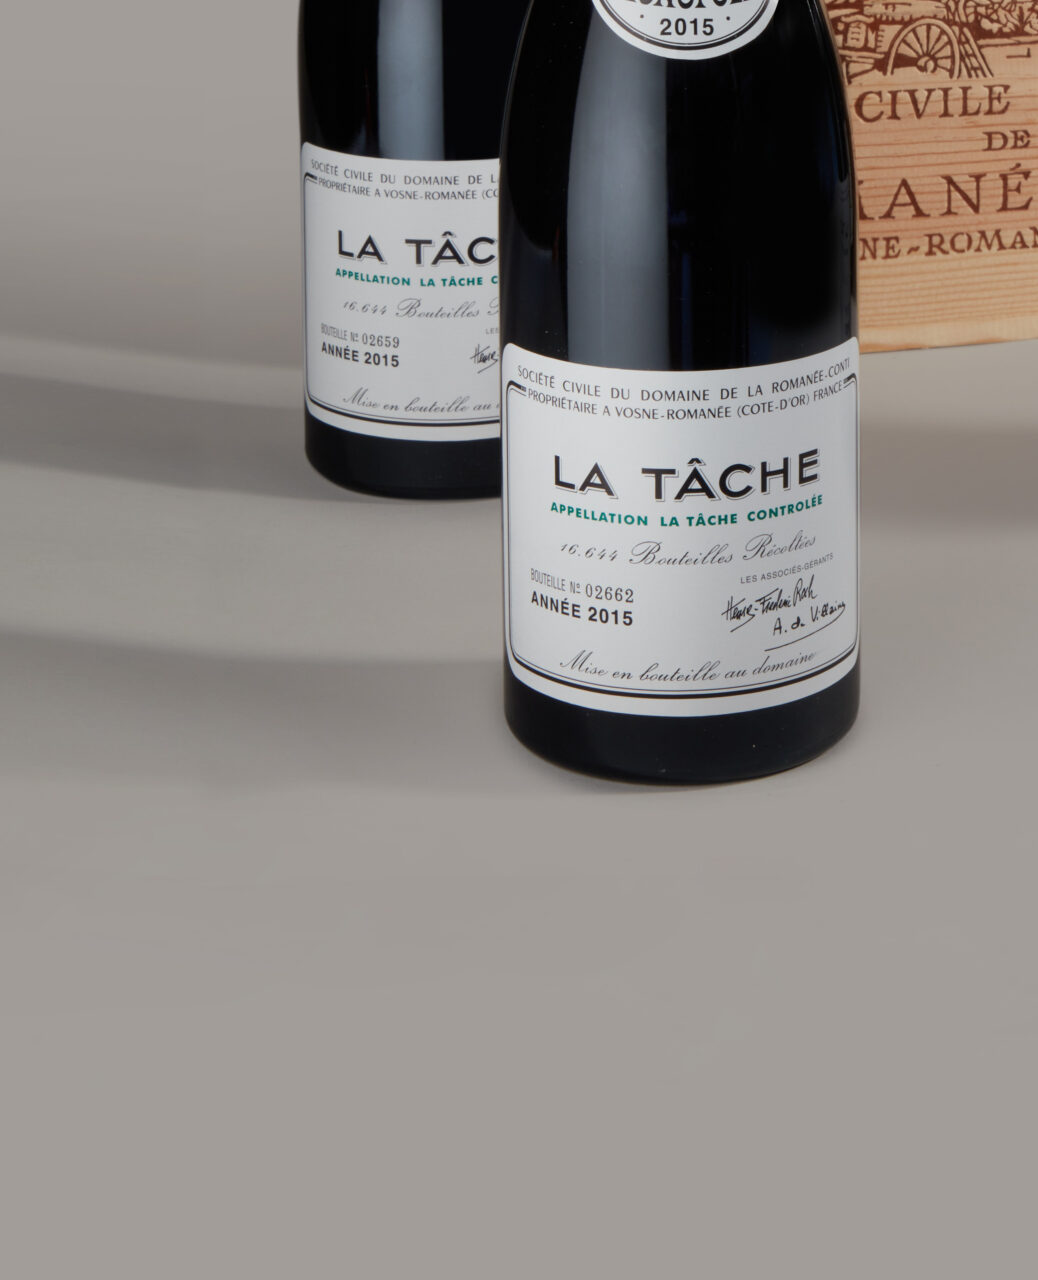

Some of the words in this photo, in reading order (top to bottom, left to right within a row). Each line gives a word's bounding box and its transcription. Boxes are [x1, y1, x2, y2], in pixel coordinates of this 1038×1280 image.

[659, 17, 715, 37] 2015
[854, 84, 1011, 123] CIVILE
[982, 129, 1031, 152] DE
[311, 158, 339, 177] SOCIÉTÉ
[343, 168, 374, 183] CIVILE
[380, 173, 396, 185] DU
[404, 175, 460, 186] DOMAINE
[468, 174, 483, 185] DE
[318, 177, 371, 197] PROPRIÉTAIRE
[374, 189, 381, 197] A
[384, 189, 477, 201] VOSNE-ROMANÉE
[338, 230, 387, 265] LA
[335, 268, 411, 286] APPELLATION
[420, 277, 436, 287] LA
[441, 275, 483, 287] TÂCHE
[395, 297, 480, 318] Bouteilles
[321, 322, 348, 341] BOUTEILLE
[361, 332, 400, 348] 02659
[321, 341, 359, 362] ANNÉE
[364, 352, 400, 368] 2015
[517, 365, 556, 389] SOCIÉTÉ
[562, 380, 601, 397] CIVILE
[610, 387, 630, 400] DU
[640, 389, 710, 402] DOMAINE
[720, 387, 738, 400] DE
[747, 384, 763, 397] LA
[771, 357, 850, 394] ROMANÉE-CONTI
[342, 386, 378, 409] Mise
[383, 403, 399, 411] en
[404, 395, 468, 413] bouteille
[473, 402, 492, 411] au
[528, 388, 598, 415] PROPRIÉTAIRE
[602, 405, 611, 417] A
[615, 405, 731, 420] VOSNE-ROMANÉE
[736, 394, 810, 418] (COTE-D'OR)
[813, 379, 843, 402] FRANCE
[554, 455, 618, 499] LA
[641, 448, 820, 502] TÂCHE
[550, 502, 649, 526] APPELLATION
[660, 516, 680, 527] LA
[686, 513, 738, 527] TÂCHE
[747, 494, 823, 522] CONTROLÉE
[629, 540, 733, 566] Bouteilles
[742, 529, 816, 561] Récoltées
[530, 568, 566, 592] BOUTEILLE
[585, 583, 634, 603] 02662
[740, 574, 758, 584] LES
[531, 590, 581, 619] ANNÉE
[588, 606, 633, 626] 2015
[559, 649, 607, 676] Mise
[612, 669, 633, 681] en
[639, 662, 720, 683] bouteille
[724, 666, 748, 679] au
[752, 652, 816, 677] domaine
